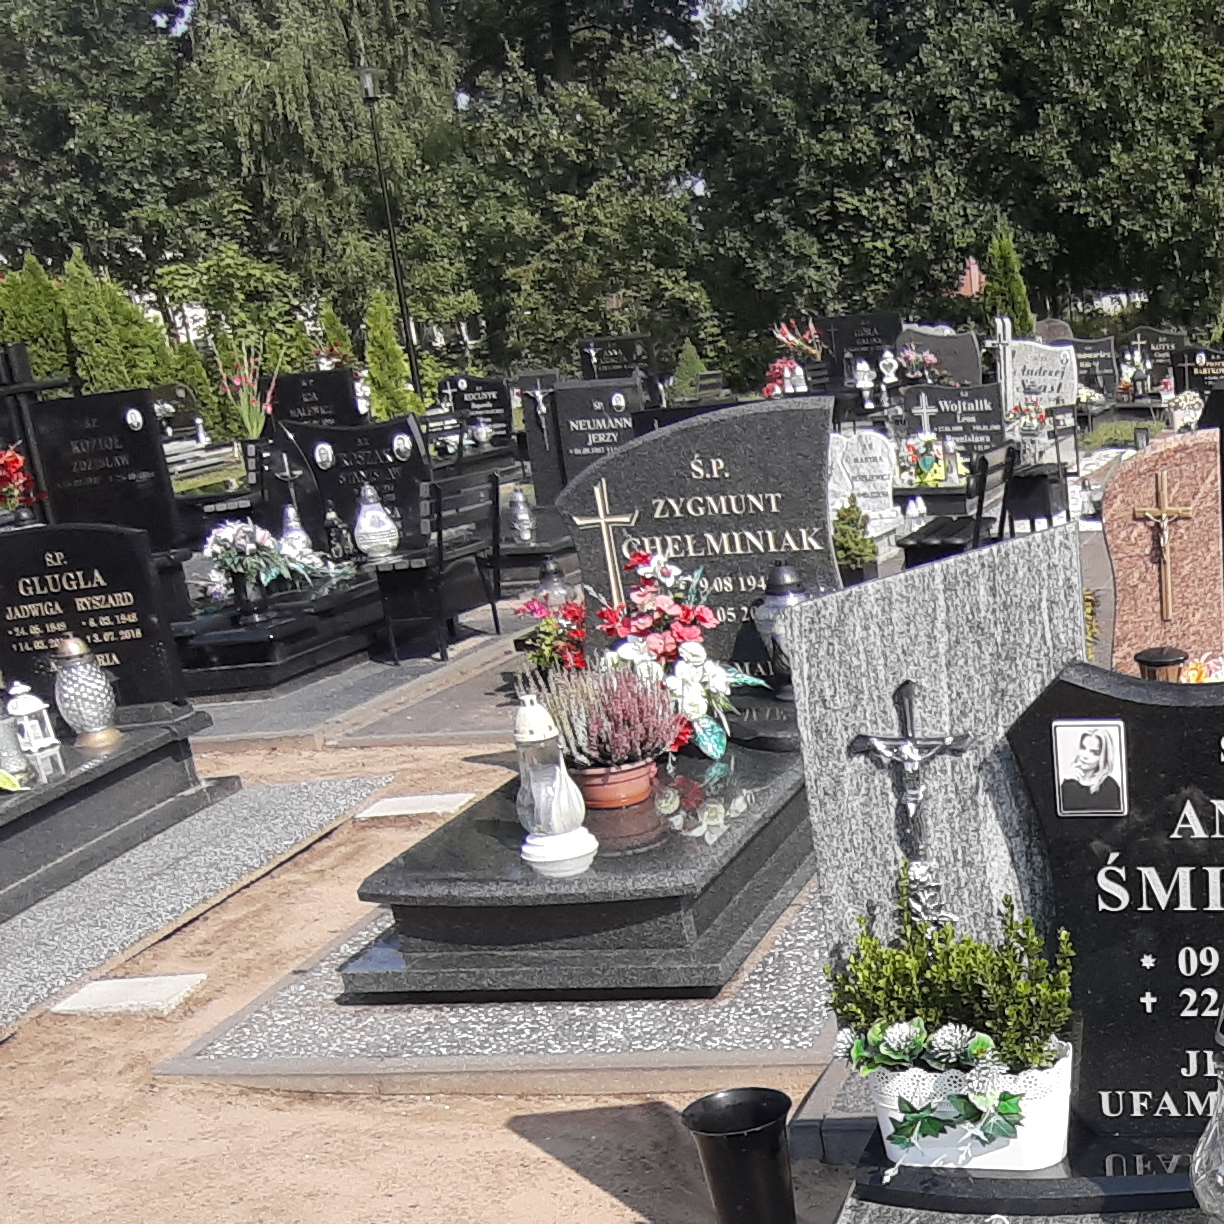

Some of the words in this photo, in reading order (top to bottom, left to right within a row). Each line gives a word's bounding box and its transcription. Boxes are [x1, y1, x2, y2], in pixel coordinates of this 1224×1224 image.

[938, 398, 994, 413] Wojtalik
[568, 417, 634, 433] NEUMANN
[587, 432, 619, 447] JERZY
[651, 493, 783, 519] ZYGMUNT
[622, 527, 825, 560] CHEŁMINIAK
[713, 576, 735, 593] 08
[738, 575, 768, 592] 194
[5, 600, 64, 621] JADWIGA
[74, 591, 136, 612] RYSZARD
[1177, 945, 1220, 977] 09
[1178, 987, 1220, 1018] 22
[1099, 1090, 1218, 1118] UFAM
